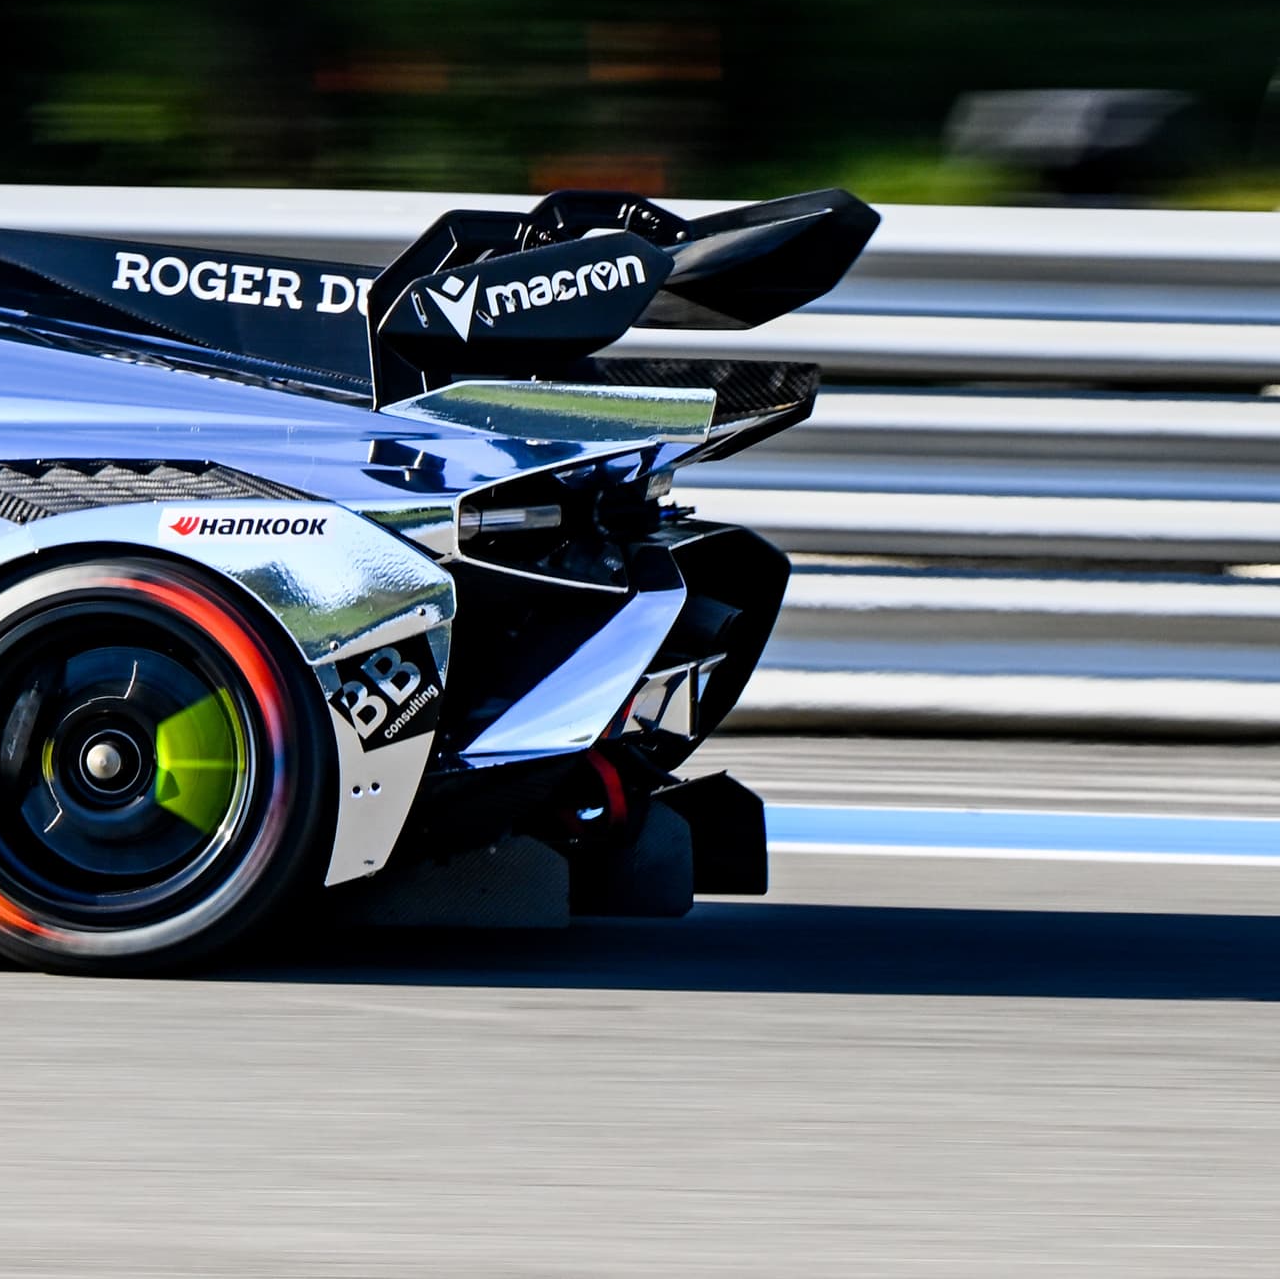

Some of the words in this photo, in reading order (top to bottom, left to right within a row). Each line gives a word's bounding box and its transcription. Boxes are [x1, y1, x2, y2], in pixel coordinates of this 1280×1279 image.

[112, 251, 302, 310] ROGER
[486, 255, 646, 317] macron
[340, 646, 422, 740] BB
[383, 683, 440, 740] consulting
